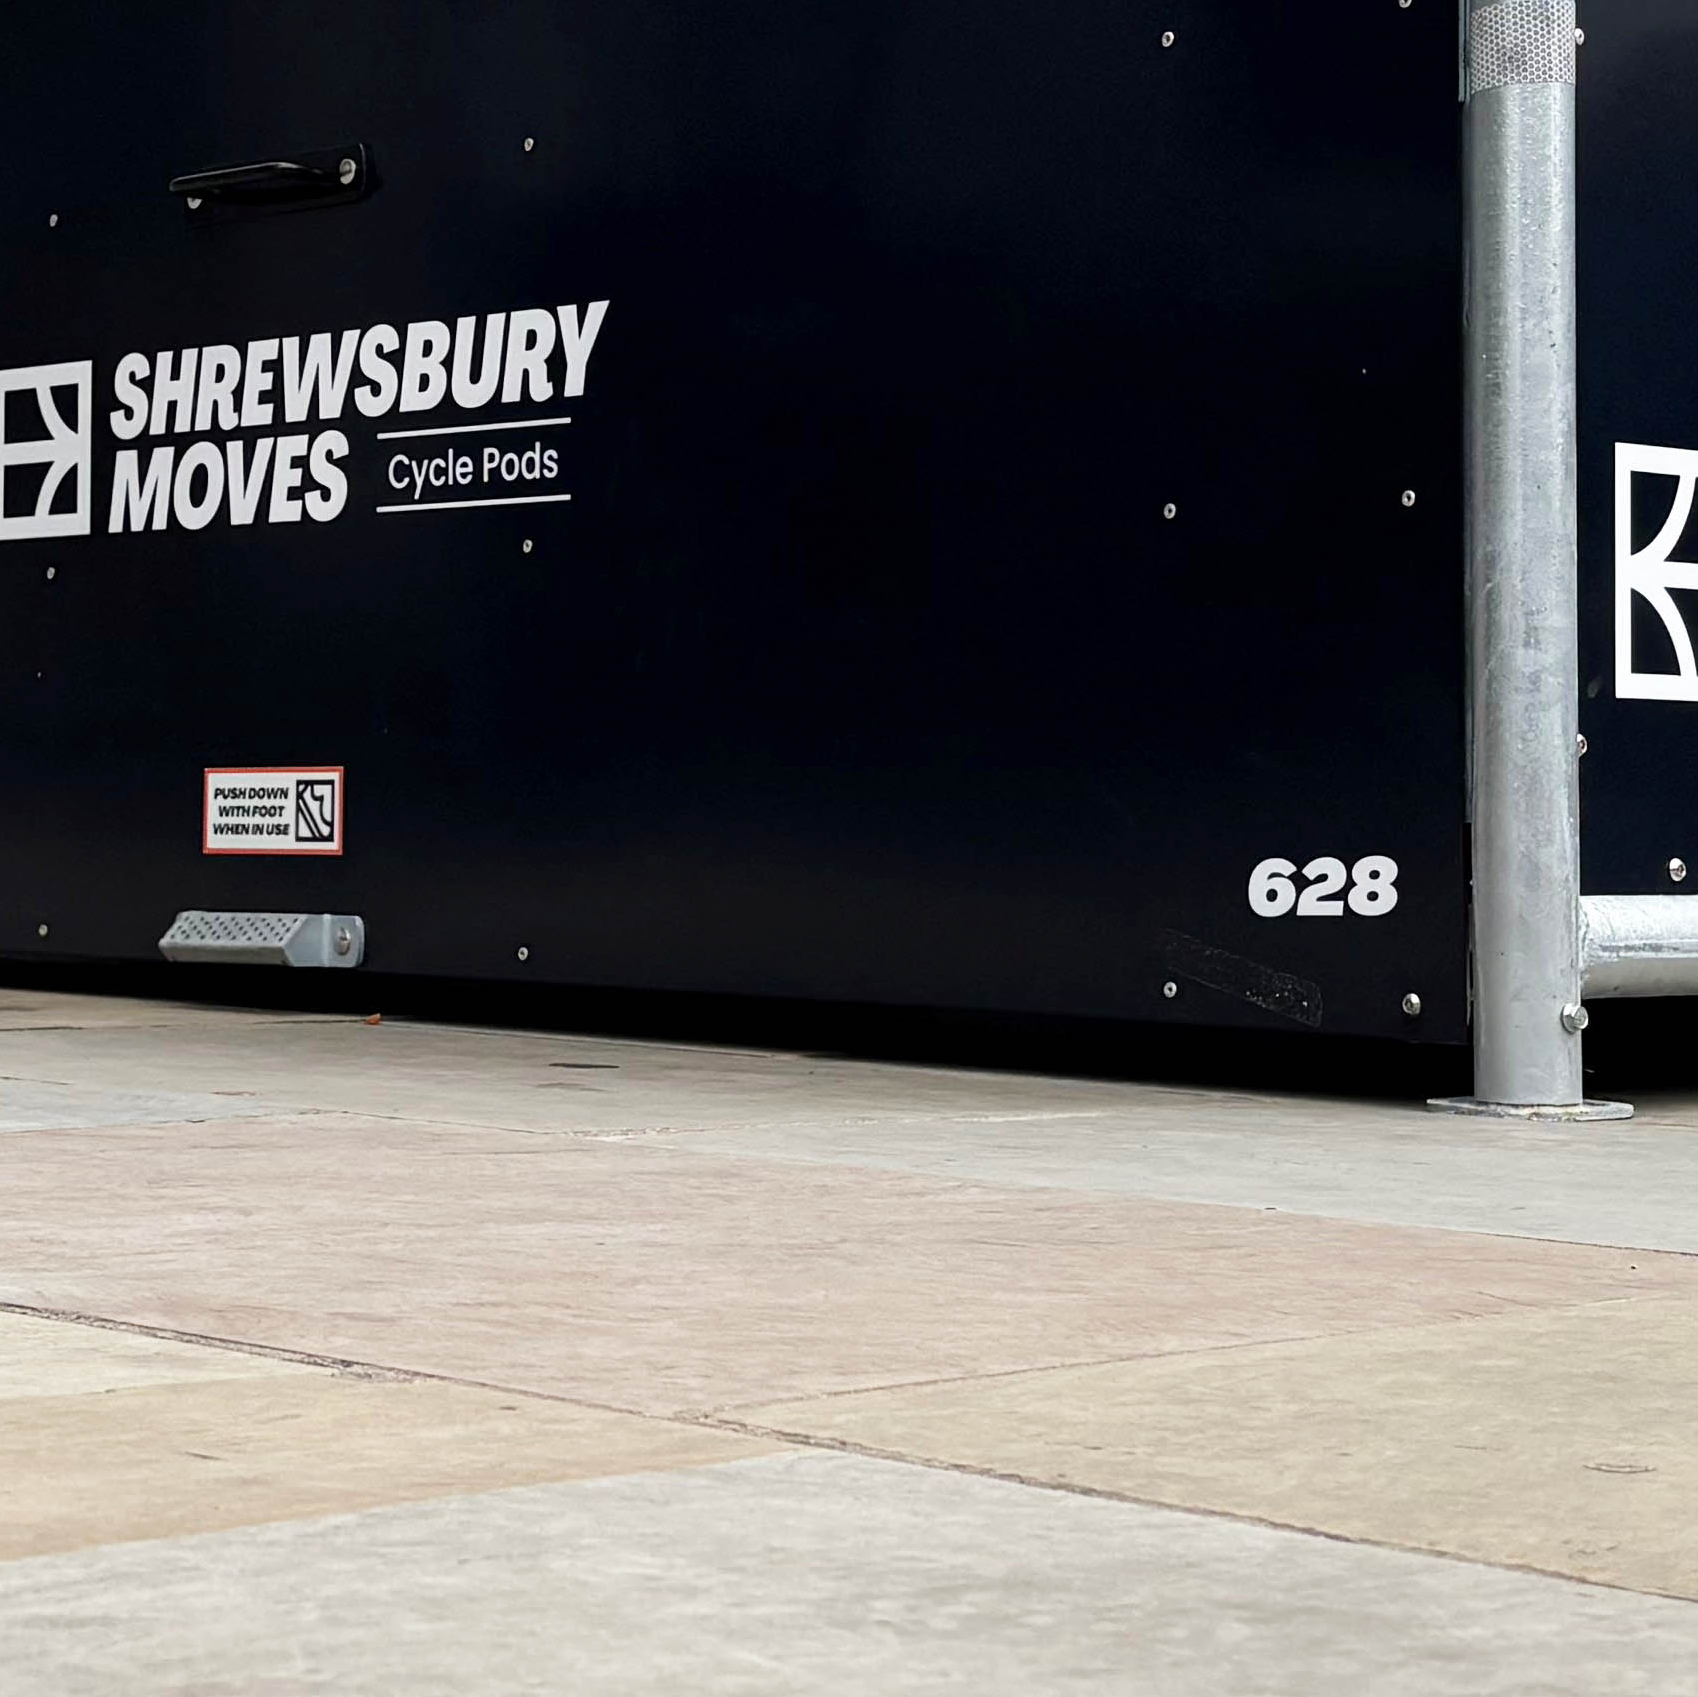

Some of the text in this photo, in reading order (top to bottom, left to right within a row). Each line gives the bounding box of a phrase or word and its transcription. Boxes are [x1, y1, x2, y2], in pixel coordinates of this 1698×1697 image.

[108, 299, 611, 441] SHREWSBURY
[108, 429, 350, 534] MOVES
[388, 441, 560, 500] Cycle Pods
[213, 787, 289, 800] PUSH DOWN
[218, 805, 286, 818] WITH FOOT
[213, 823, 291, 836] WHEN IN USE
[1248, 855, 1399, 918] 628
